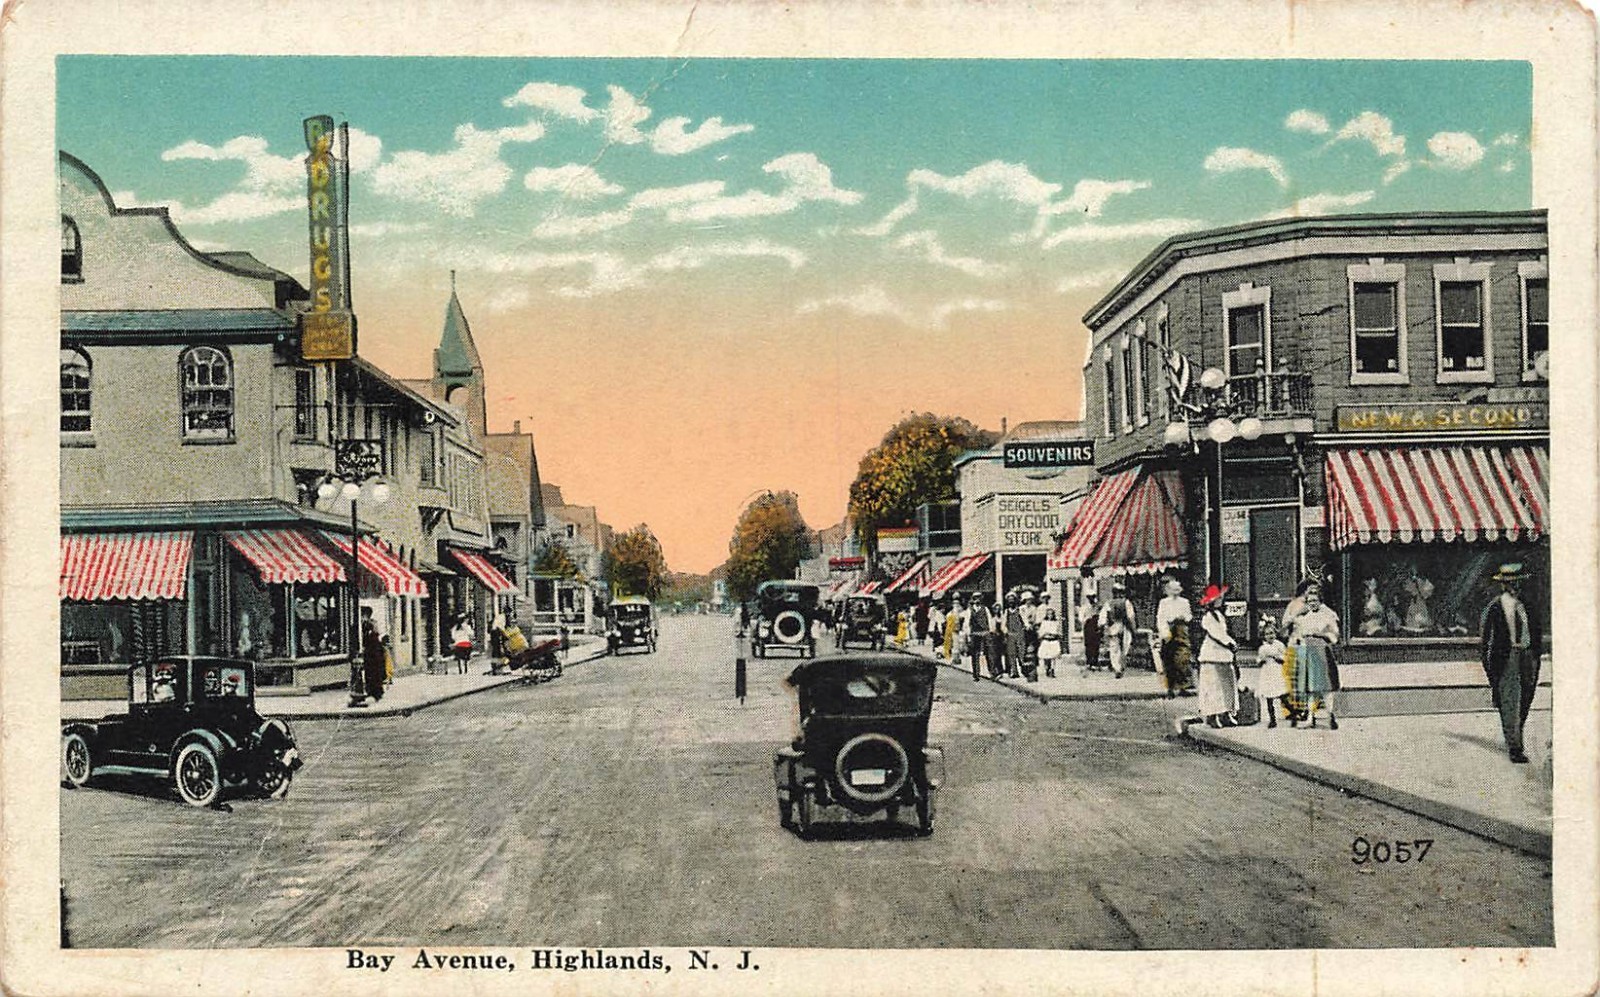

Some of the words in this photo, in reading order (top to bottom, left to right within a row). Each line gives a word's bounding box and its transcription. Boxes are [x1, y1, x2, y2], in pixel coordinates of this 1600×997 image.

[1352, 410, 1402, 427] NEW
[1006, 446, 1092, 463] SOUVENIRS
[999, 514, 1023, 529] DRY
[1005, 531, 1043, 546] STORE
